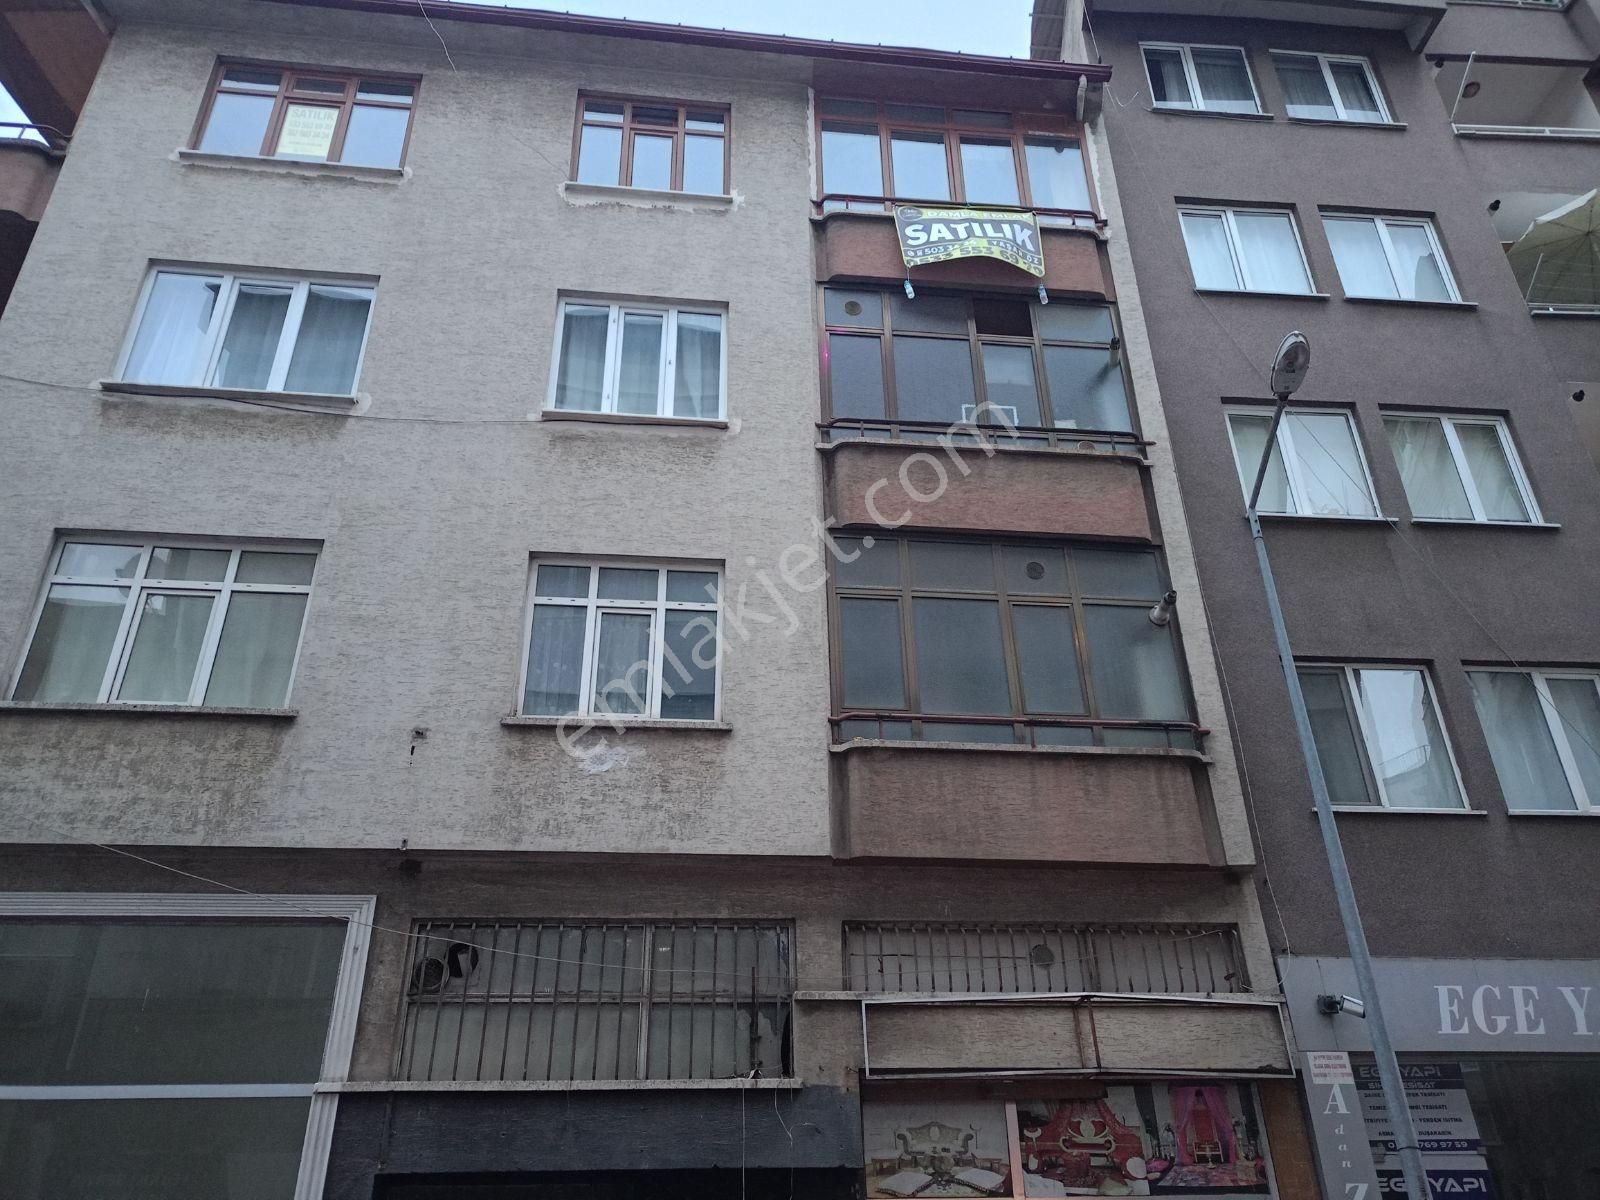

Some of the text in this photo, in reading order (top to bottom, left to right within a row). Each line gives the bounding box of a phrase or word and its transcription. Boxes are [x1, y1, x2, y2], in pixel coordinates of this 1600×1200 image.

[291, 108, 335, 120] SATILIK
[904, 222, 1035, 251] SATILIK
[1433, 984, 1600, 1036] EGE Y
[1427, 1177, 1487, 1192] YAPI
